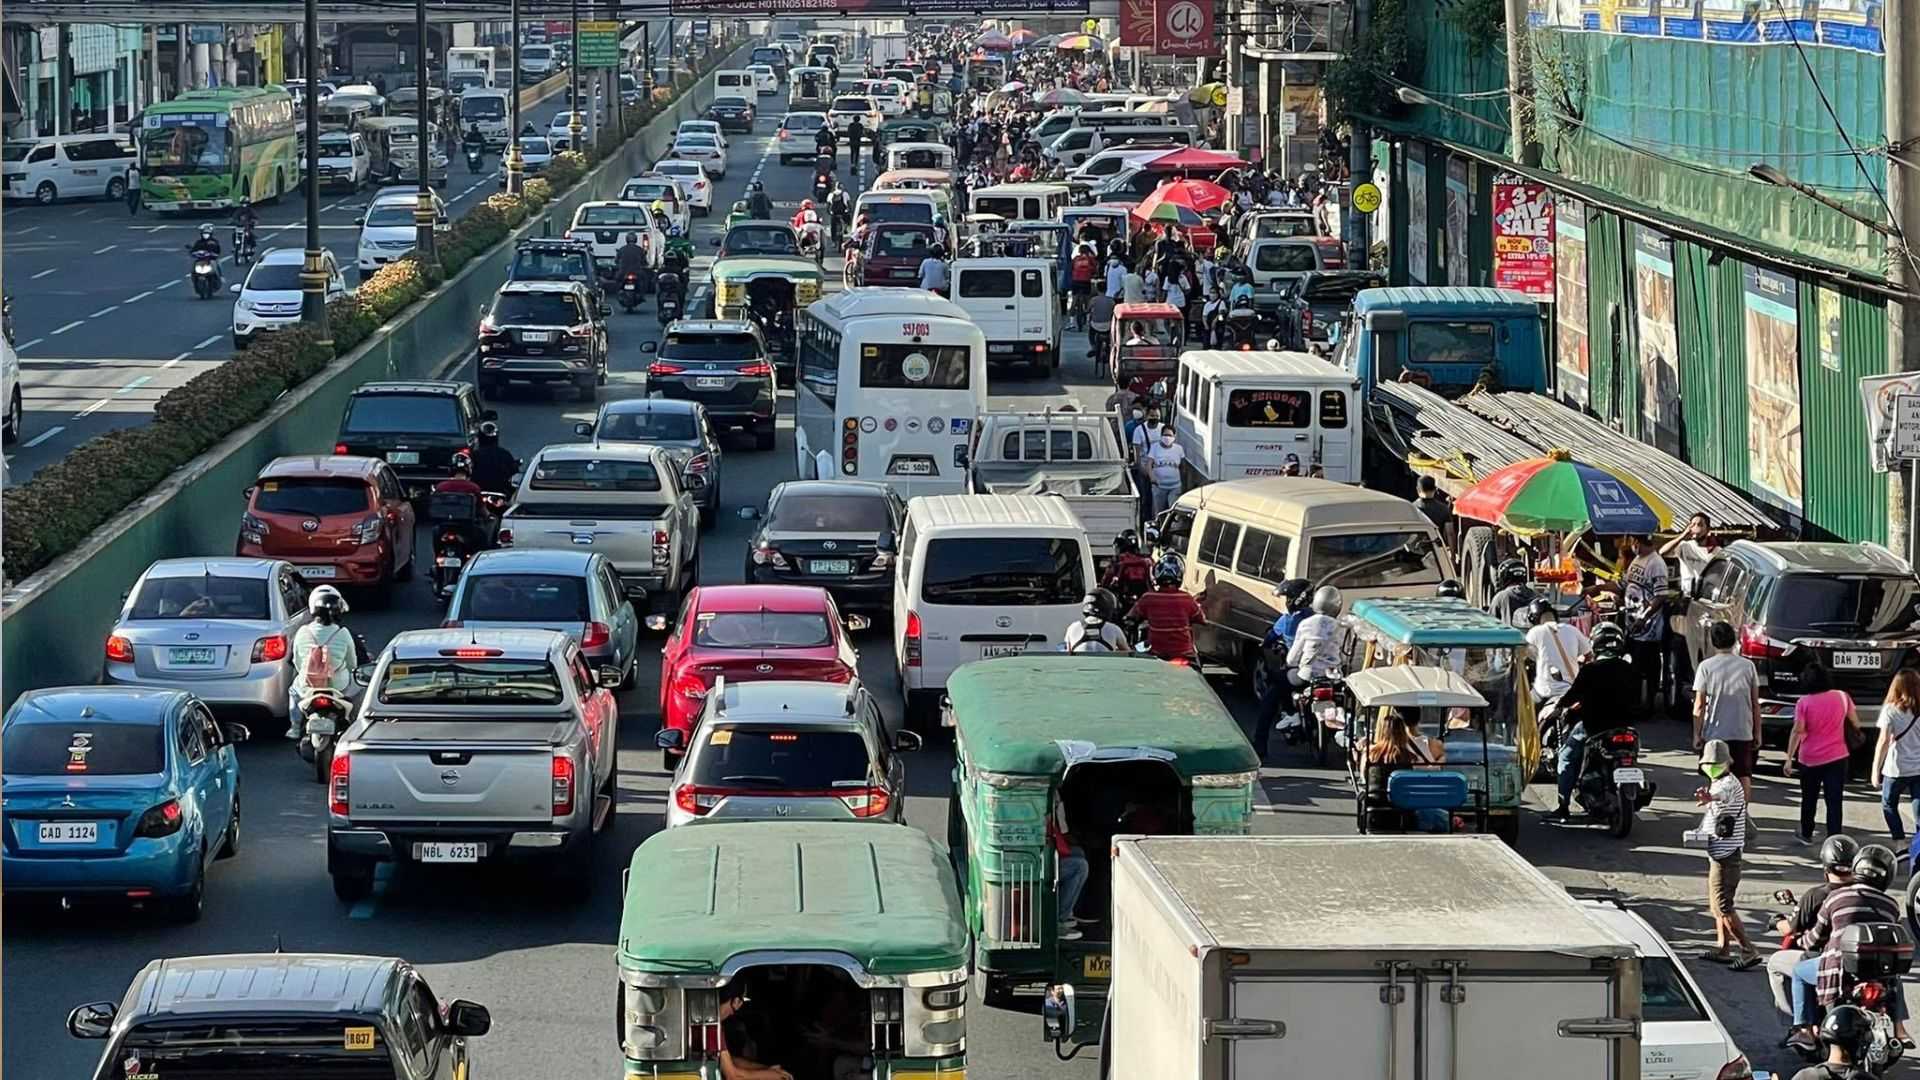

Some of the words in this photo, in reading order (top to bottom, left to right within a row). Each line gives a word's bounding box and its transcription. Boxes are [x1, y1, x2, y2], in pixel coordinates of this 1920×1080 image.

[1501, 216, 1550, 236] SALE
[1834, 655, 1852, 665] DAH
[1857, 655, 1880, 666] 7388
[40, 827, 61, 839] CAD
[68, 827, 95, 839] 1124
[423, 847, 443, 858] NBL
[450, 847, 476, 858] 6231
